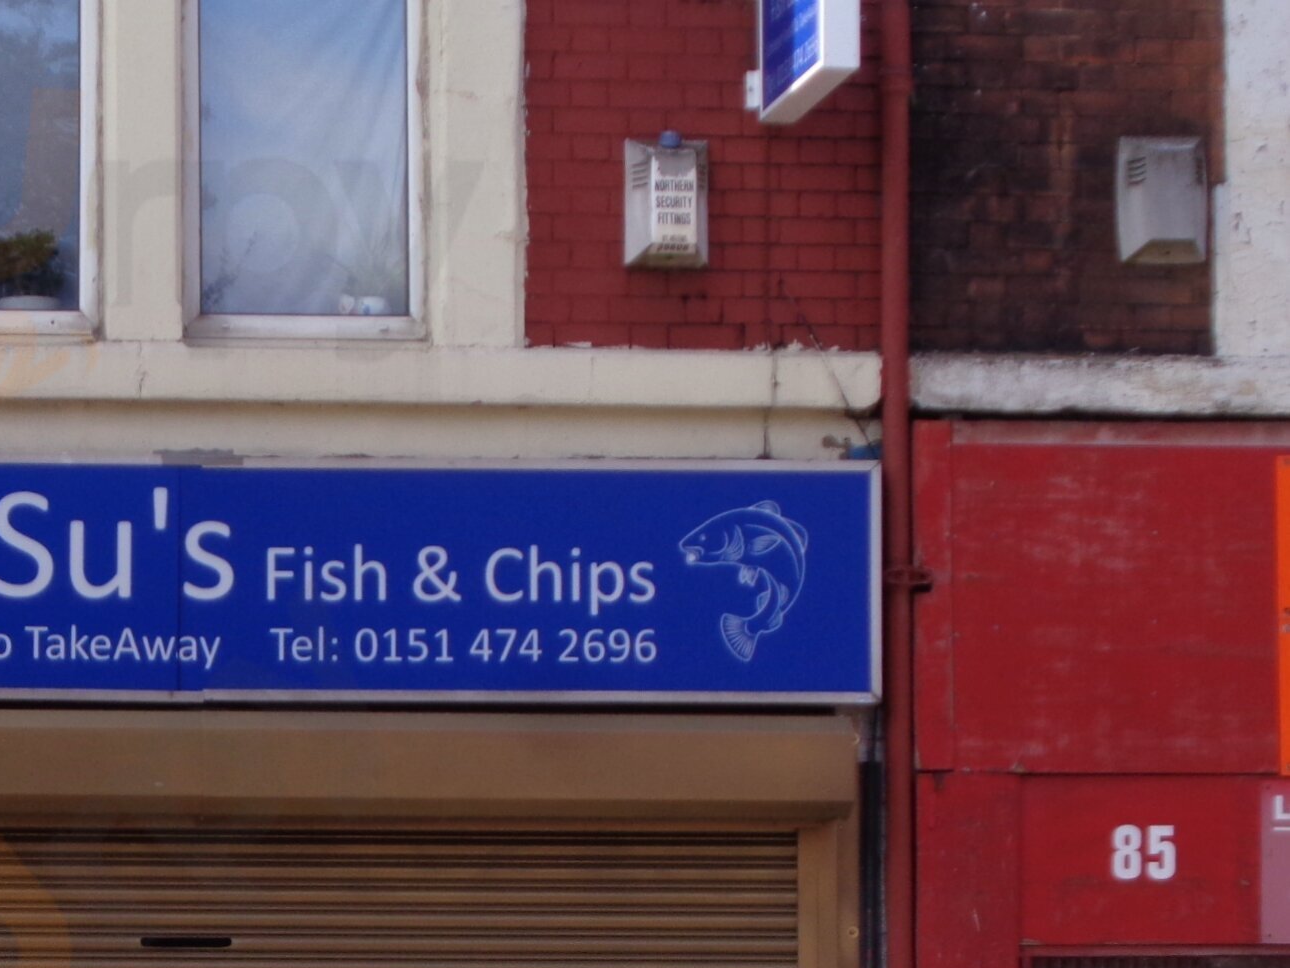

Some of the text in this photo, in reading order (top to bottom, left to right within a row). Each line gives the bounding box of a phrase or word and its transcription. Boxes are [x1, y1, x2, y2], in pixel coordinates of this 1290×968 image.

[655, 179, 694, 192] NORTHERN
[656, 195, 692, 208] SECURITY
[658, 211, 691, 224] FITTINGS
[266, 543, 387, 602] Fish
[413, 545, 462, 602] &
[485, 544, 656, 616] Chips
[25, 625, 221, 670] TakeAway
[270, 626, 657, 663] Tel: 0151 474 2696
[1113, 825, 1176, 880] 85
